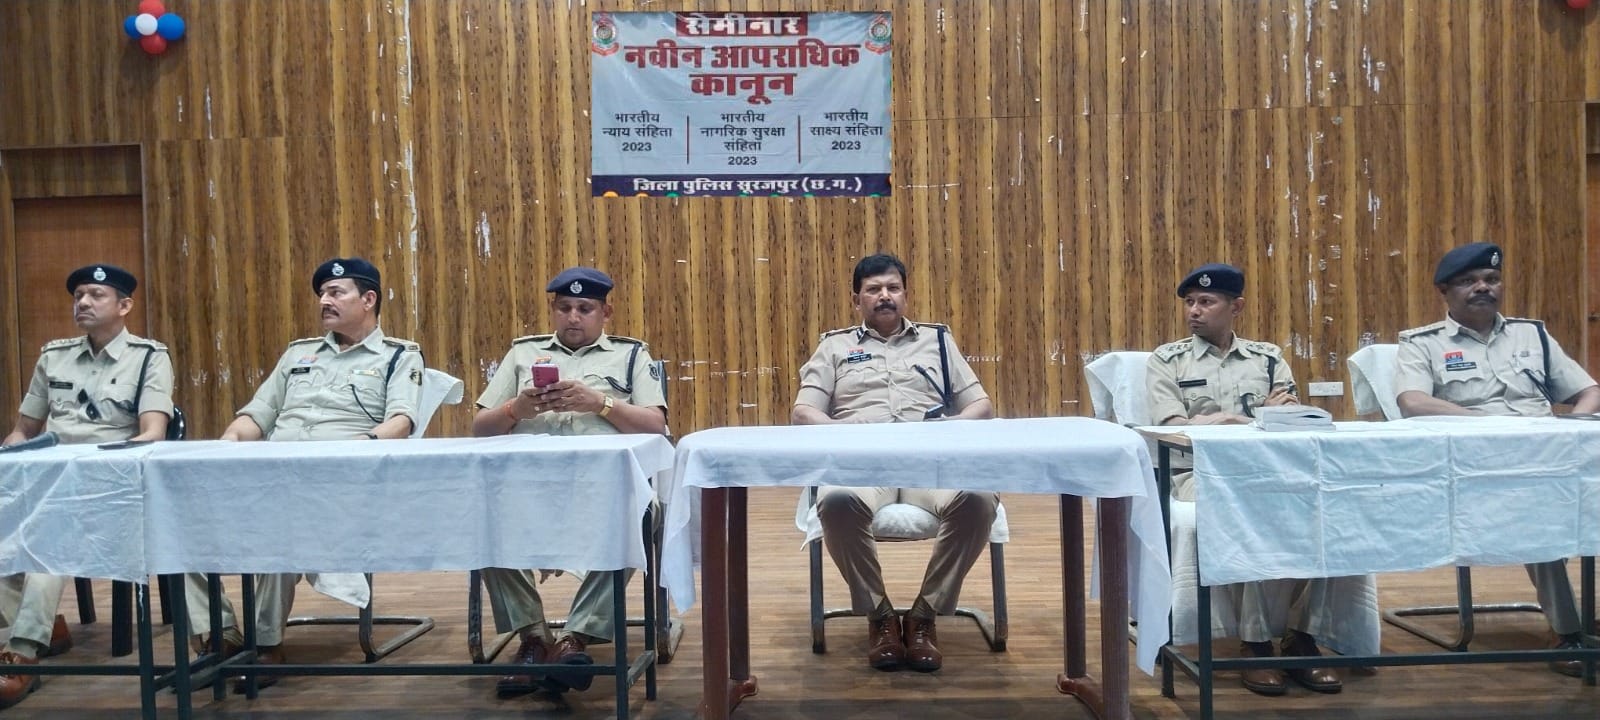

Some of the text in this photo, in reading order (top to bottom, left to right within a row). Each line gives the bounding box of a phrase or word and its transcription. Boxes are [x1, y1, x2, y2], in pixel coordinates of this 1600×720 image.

[685, 12, 800, 35] सेमीनार
[624, 38, 705, 68] नवीन
[711, 38, 861, 68] आपराधिक
[689, 73, 797, 104] कानून
[615, 110, 660, 123] भारतीय
[720, 110, 765, 123] भारतीय
[823, 108, 868, 121] भारतीय
[602, 125, 673, 138] न्याय संहिता
[700, 125, 786, 140] नागरिक सुरक्षा
[809, 123, 883, 136] साक्ष्य संहिता
[622, 142, 652, 152] 2023
[724, 139, 762, 152] संहिता
[831, 141, 861, 150] 2023
[727, 156, 758, 166] 2023
[633, 177, 862, 195] जिला पुलिस सूरजपुर (छ.ग.)
